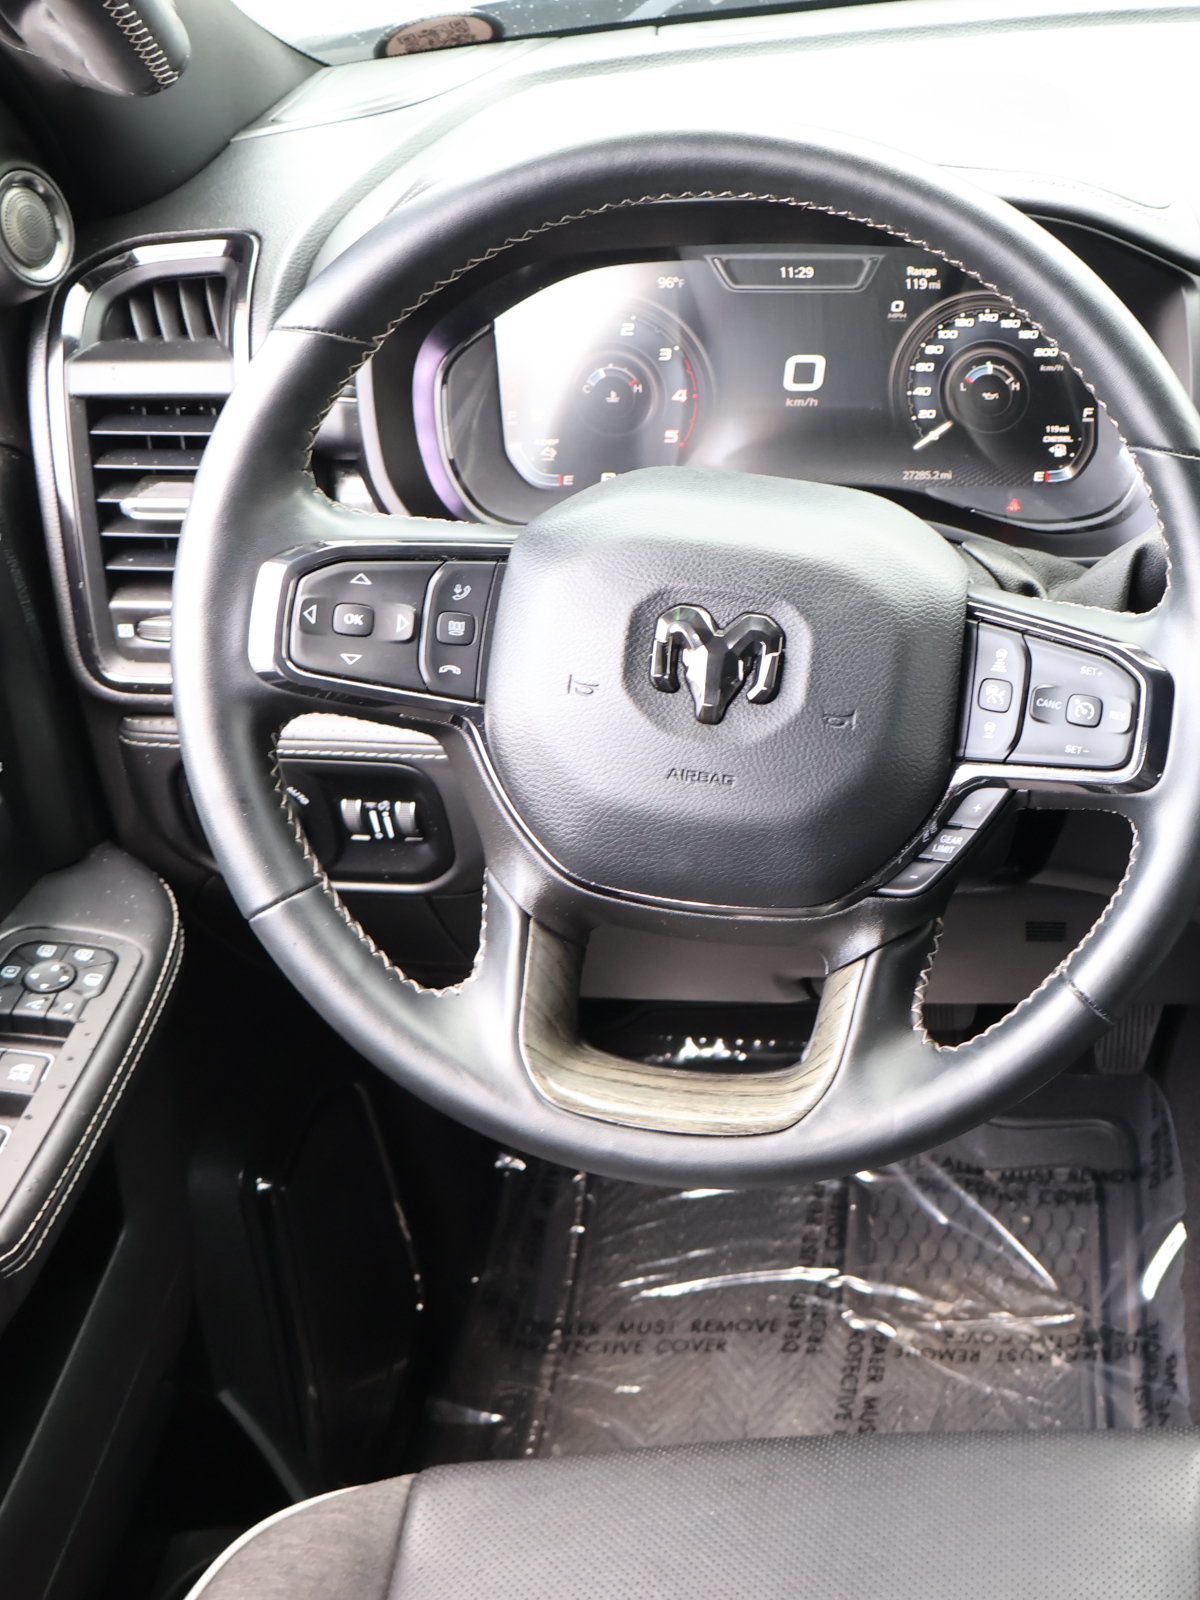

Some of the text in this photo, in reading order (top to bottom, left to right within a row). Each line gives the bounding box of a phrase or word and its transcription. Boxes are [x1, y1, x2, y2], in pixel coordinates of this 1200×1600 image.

[779, 267, 815, 279] 11:29
[906, 266, 938, 278] Range
[657, 276, 686, 289] 96°F
[619, 322, 636, 337] 2
[937, 329, 959, 340] 100
[658, 347, 673, 361] 3
[783, 354, 826, 392] 0
[671, 387, 689, 403] 4
[912, 386, 932, 397] 40
[785, 397, 818, 408] km/h
[917, 409, 937, 420] 20
[1082, 407, 1095, 418] F
[663, 428, 680, 444] 5
[343, 613, 364, 625] OK
[1036, 697, 1063, 710] CANC
[1109, 710, 1127, 721] RES
[666, 766, 736, 788] AIRBAG
[939, 834, 963, 846] GEAR
[931, 842, 957, 854] LIMIT
[690, 1317, 780, 1334] REMOVE
[656, 1338, 729, 1355] COVER
